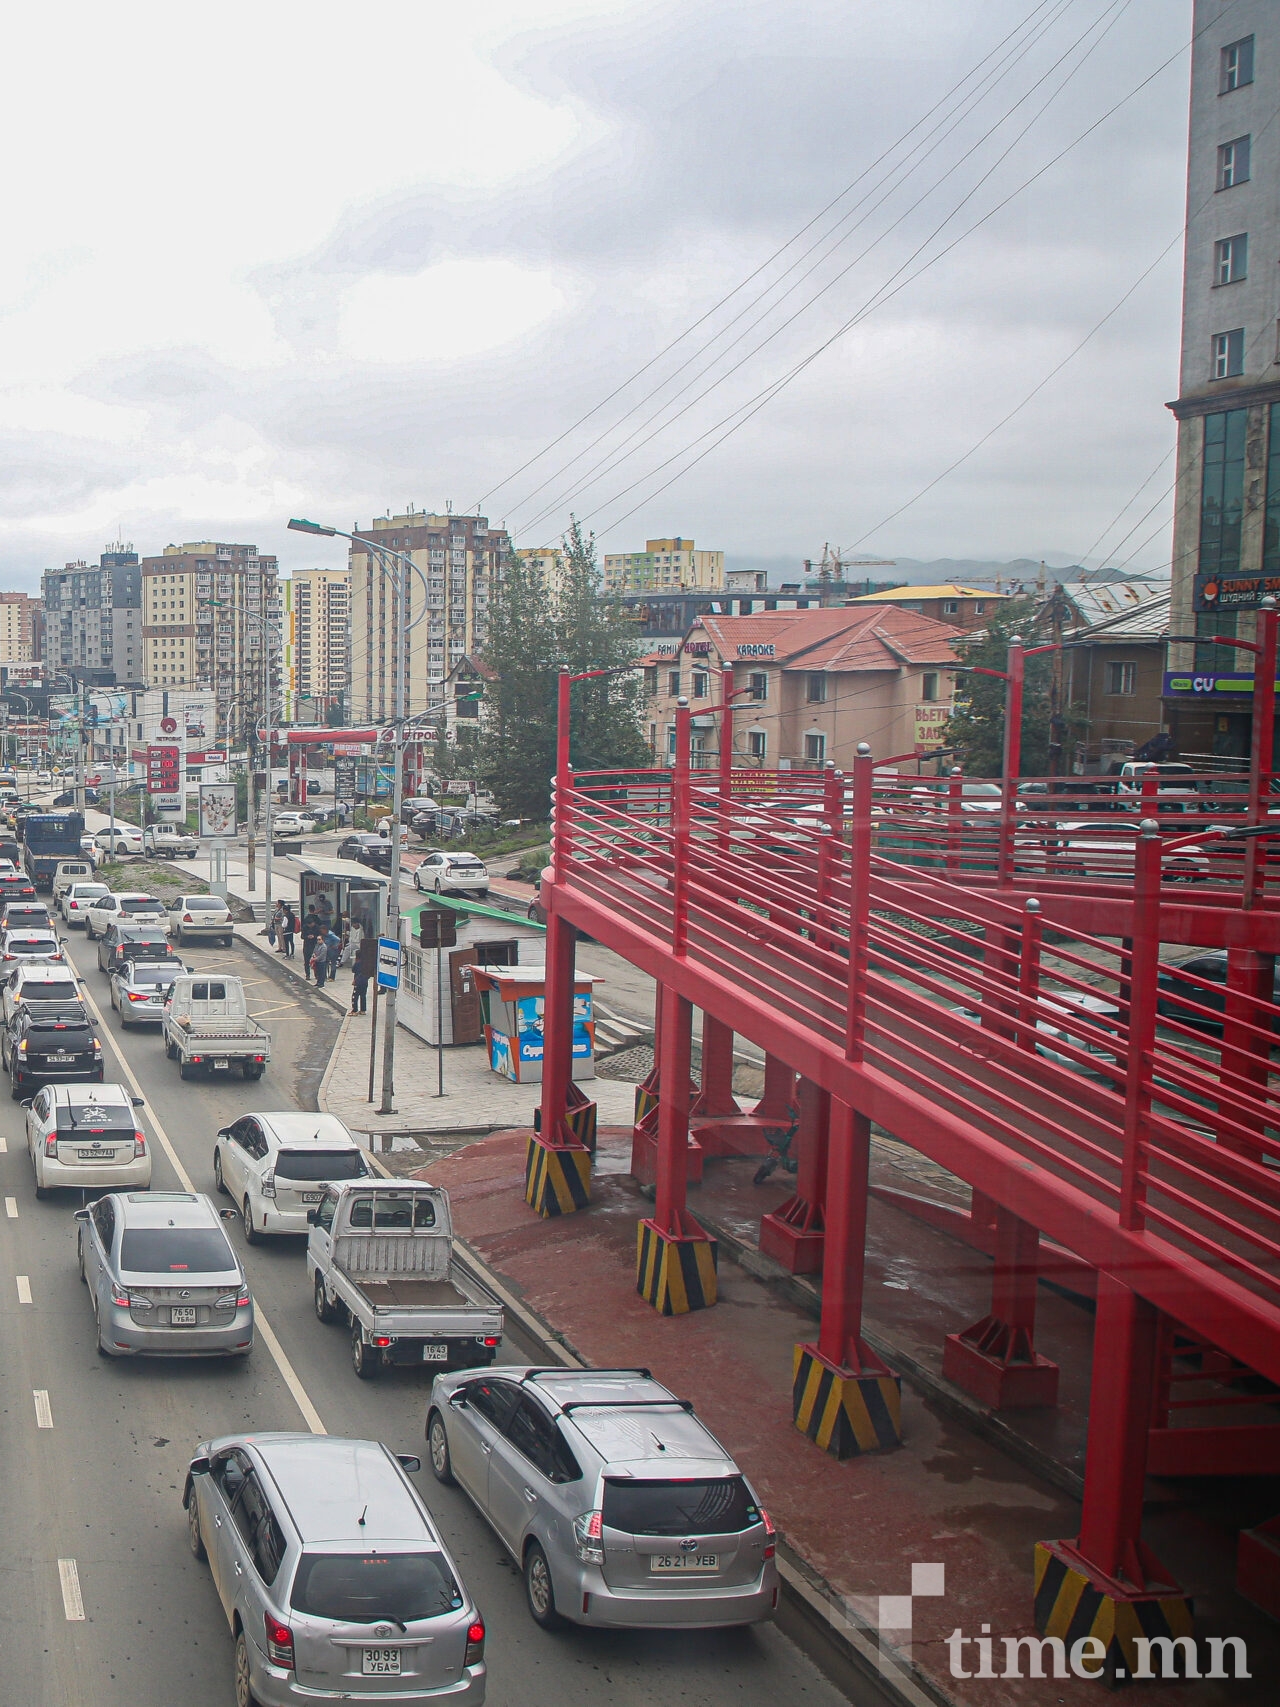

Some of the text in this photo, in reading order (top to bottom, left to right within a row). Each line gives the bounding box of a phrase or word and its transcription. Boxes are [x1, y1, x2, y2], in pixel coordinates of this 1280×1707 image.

[1222, 580, 1260, 592] SUNNY
[736, 644, 776, 656] KARAOKE
[1192, 678, 1214, 692] CU
